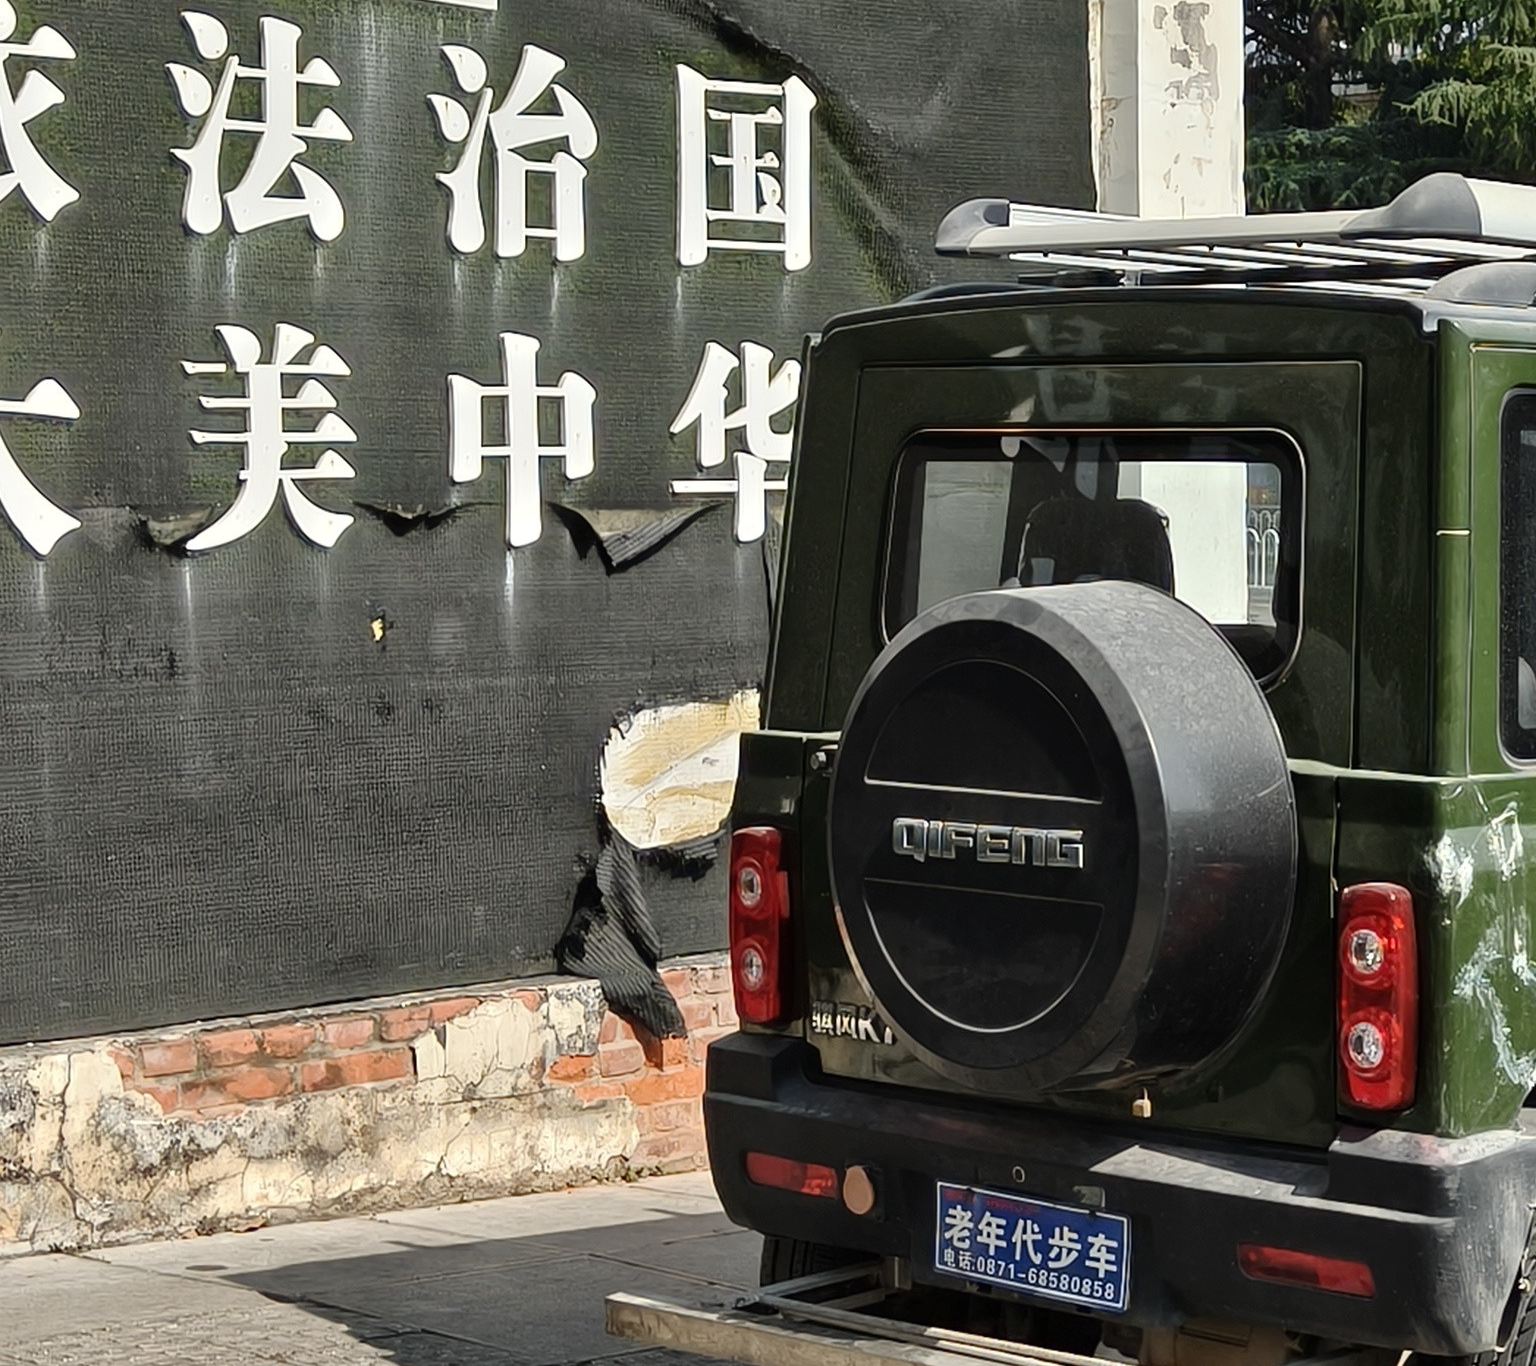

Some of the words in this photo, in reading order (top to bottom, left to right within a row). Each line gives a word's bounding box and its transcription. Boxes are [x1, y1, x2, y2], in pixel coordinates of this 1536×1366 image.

[892, 817, 1084, 869] QIFENG
[943, 1204, 1119, 1279] 老年代步车
